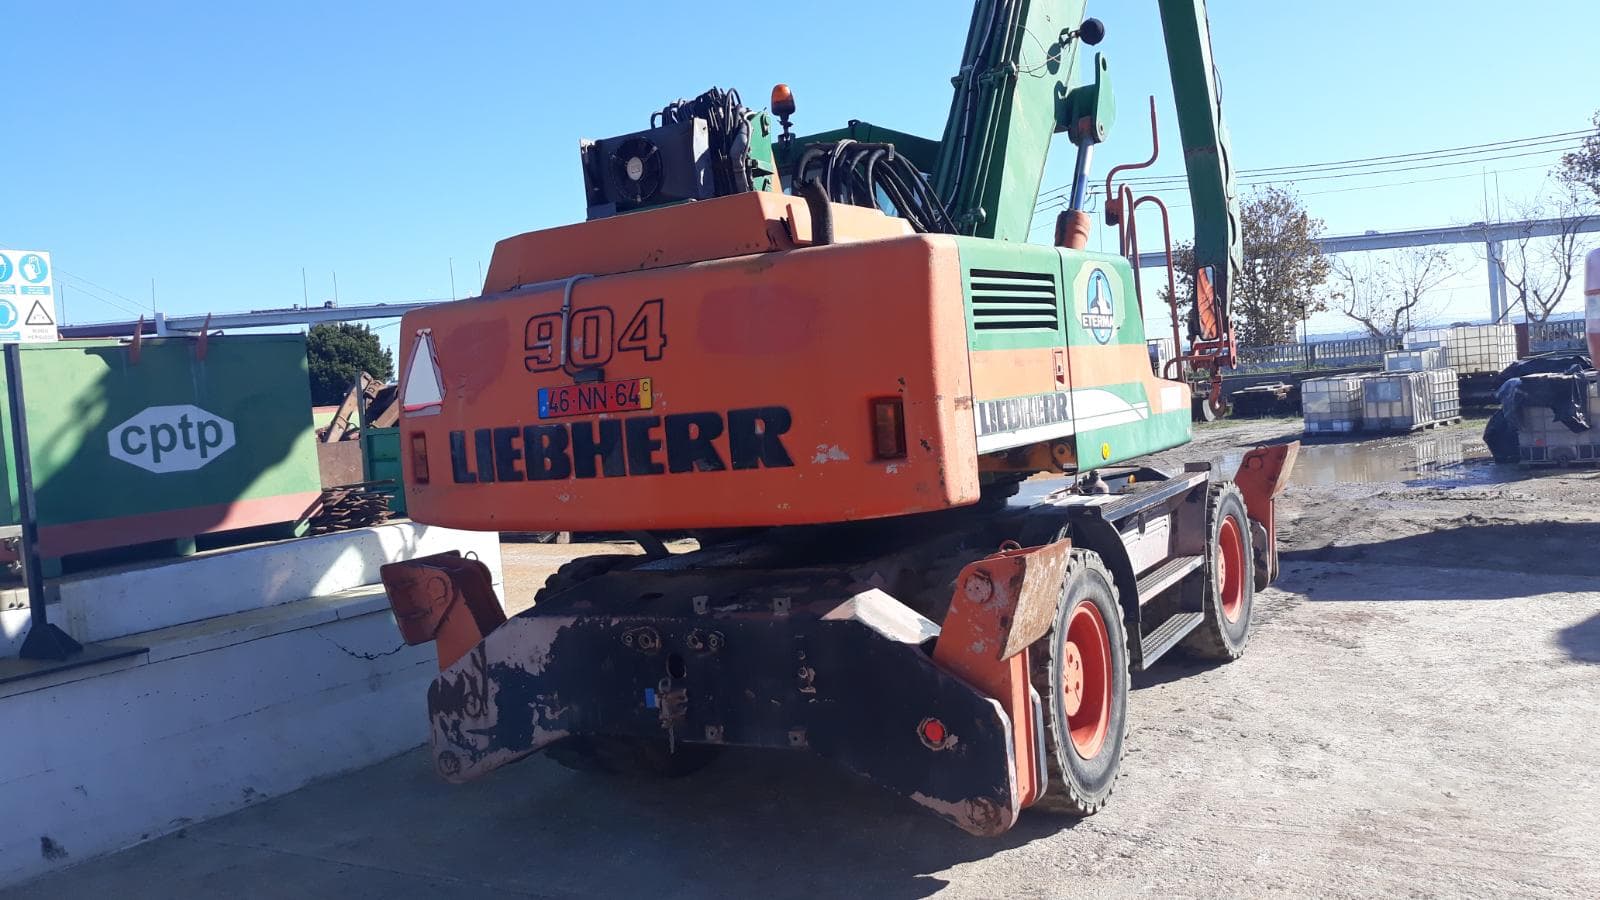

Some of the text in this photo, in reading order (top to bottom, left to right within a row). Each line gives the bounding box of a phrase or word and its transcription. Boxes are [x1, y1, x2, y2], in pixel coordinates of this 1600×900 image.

[524, 299, 667, 376] 904
[120, 414, 223, 463] cptp
[451, 406, 794, 483] LIEBHERR
